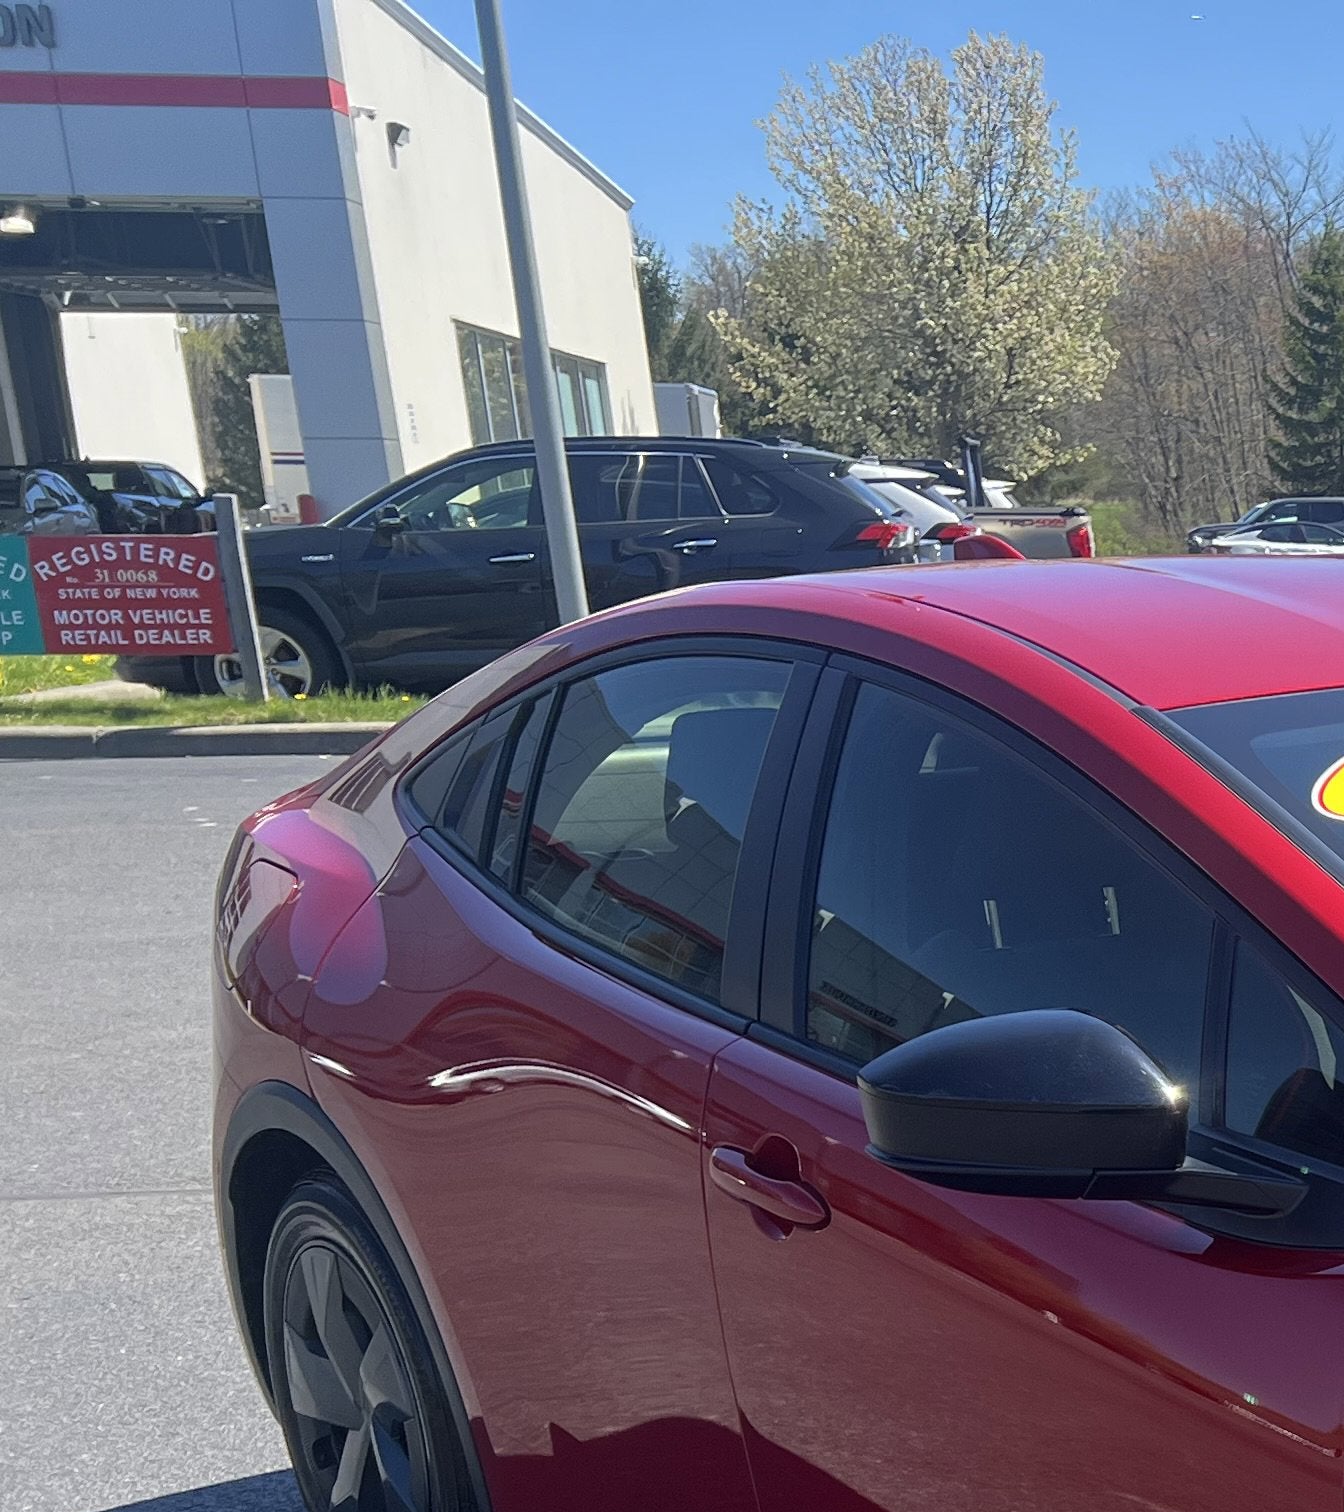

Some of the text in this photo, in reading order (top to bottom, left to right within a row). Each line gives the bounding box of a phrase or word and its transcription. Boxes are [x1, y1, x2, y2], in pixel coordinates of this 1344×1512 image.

[34, 541, 216, 581] REGISTERED
[58, 588, 199, 600] STATE OF NEW YORK
[53, 608, 213, 625] MOTOR VEHICLE
[60, 629, 213, 645] RETAIL DEALER
